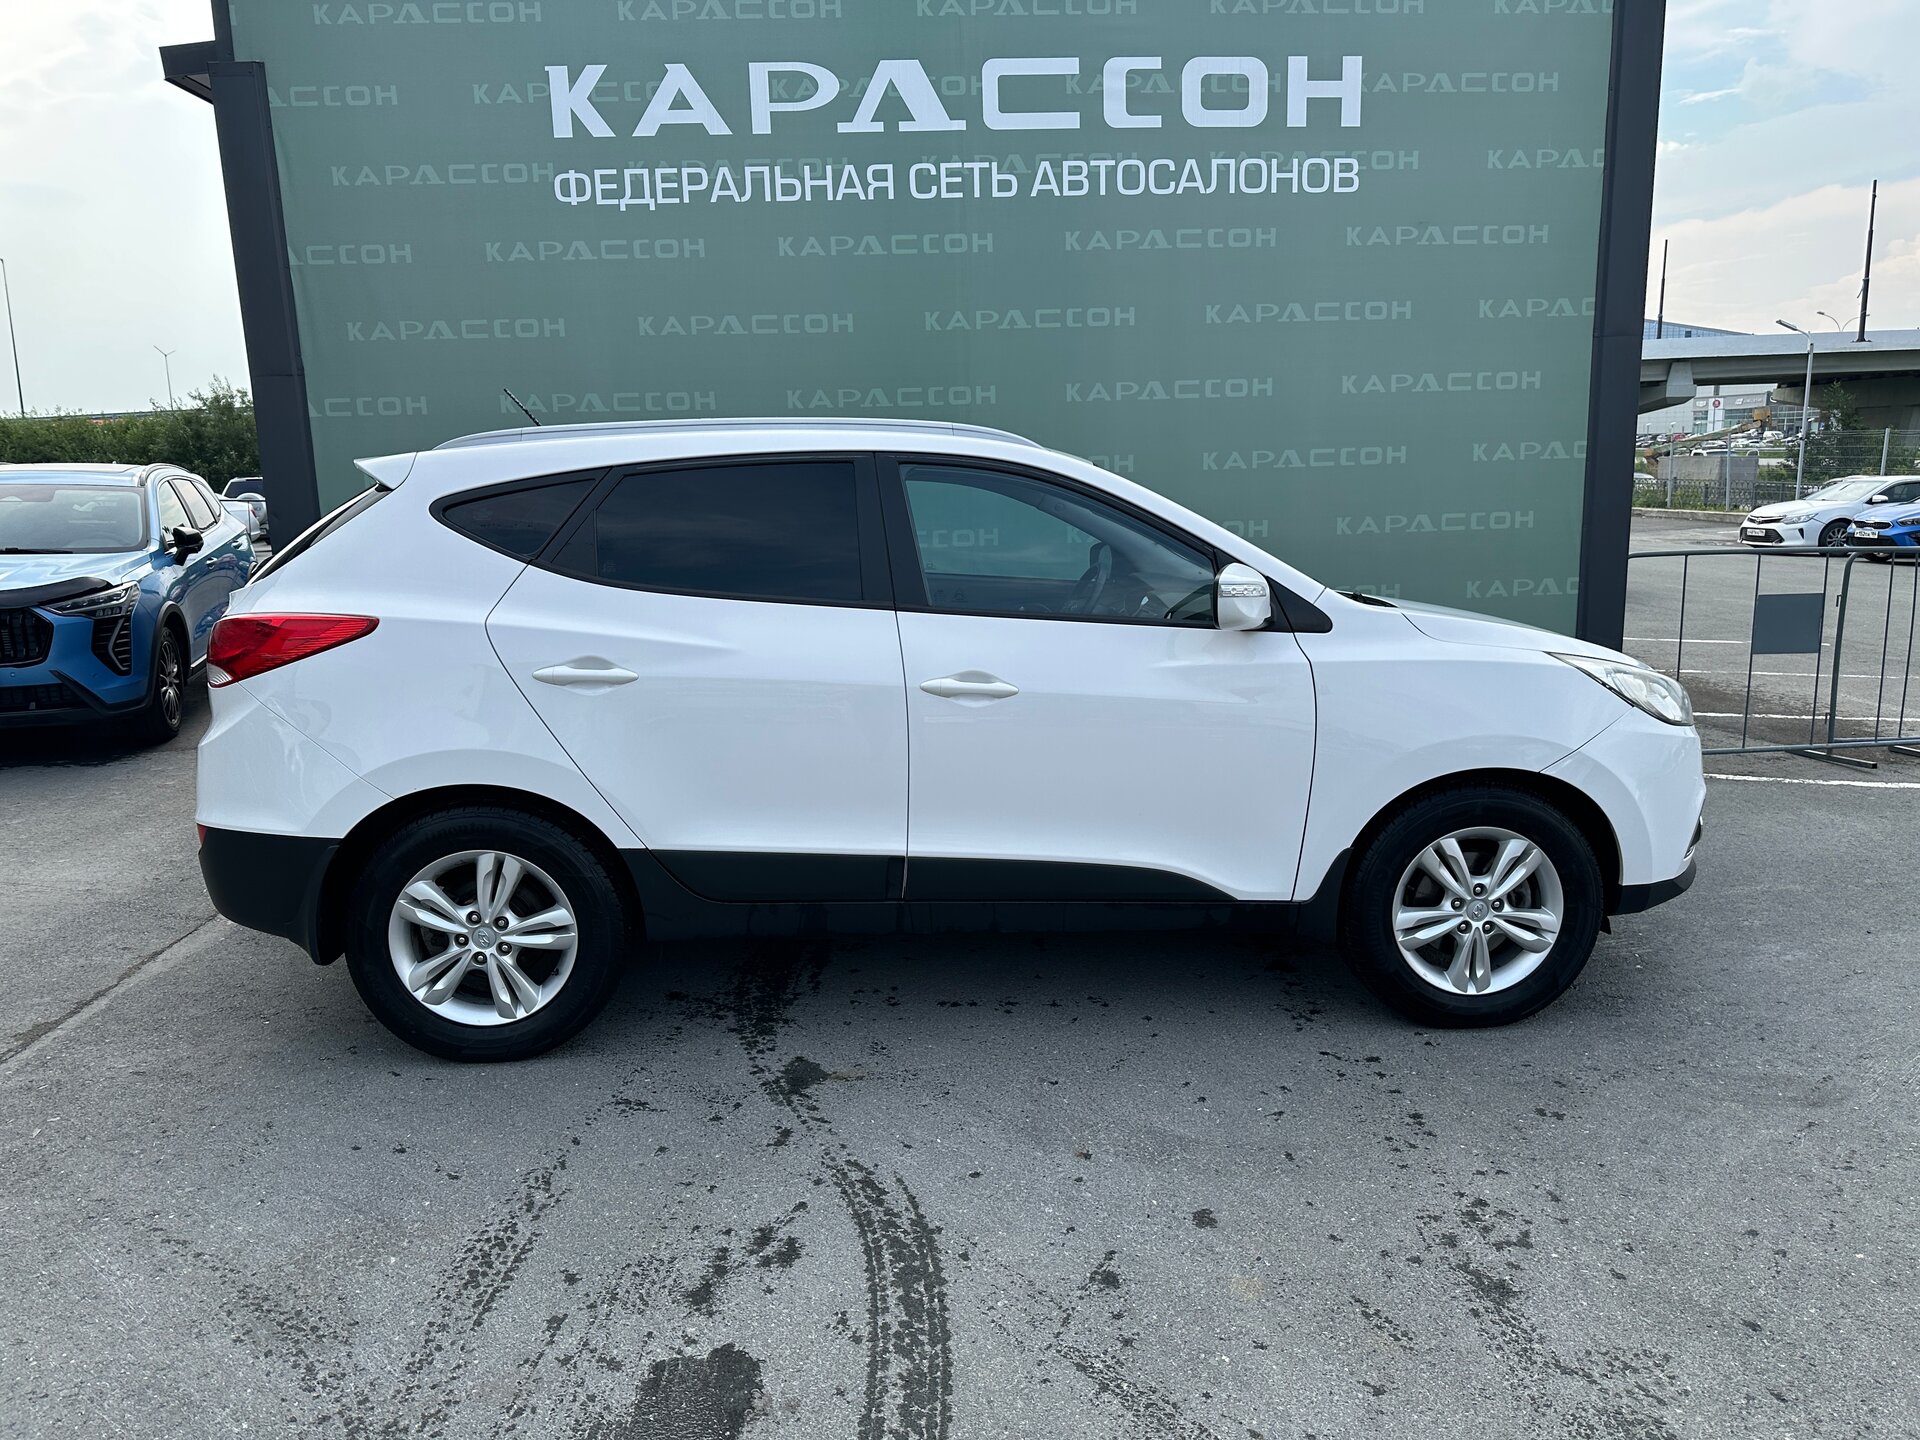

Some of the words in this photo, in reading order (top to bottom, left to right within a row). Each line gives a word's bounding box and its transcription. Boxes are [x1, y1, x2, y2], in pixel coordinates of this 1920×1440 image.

[553, 163, 895, 211] ФЕДЕРАЛЬНАЯ
[908, 160, 1019, 200] СЕТЬ
[1029, 157, 1361, 198] АВТОСАЛОНОВ
